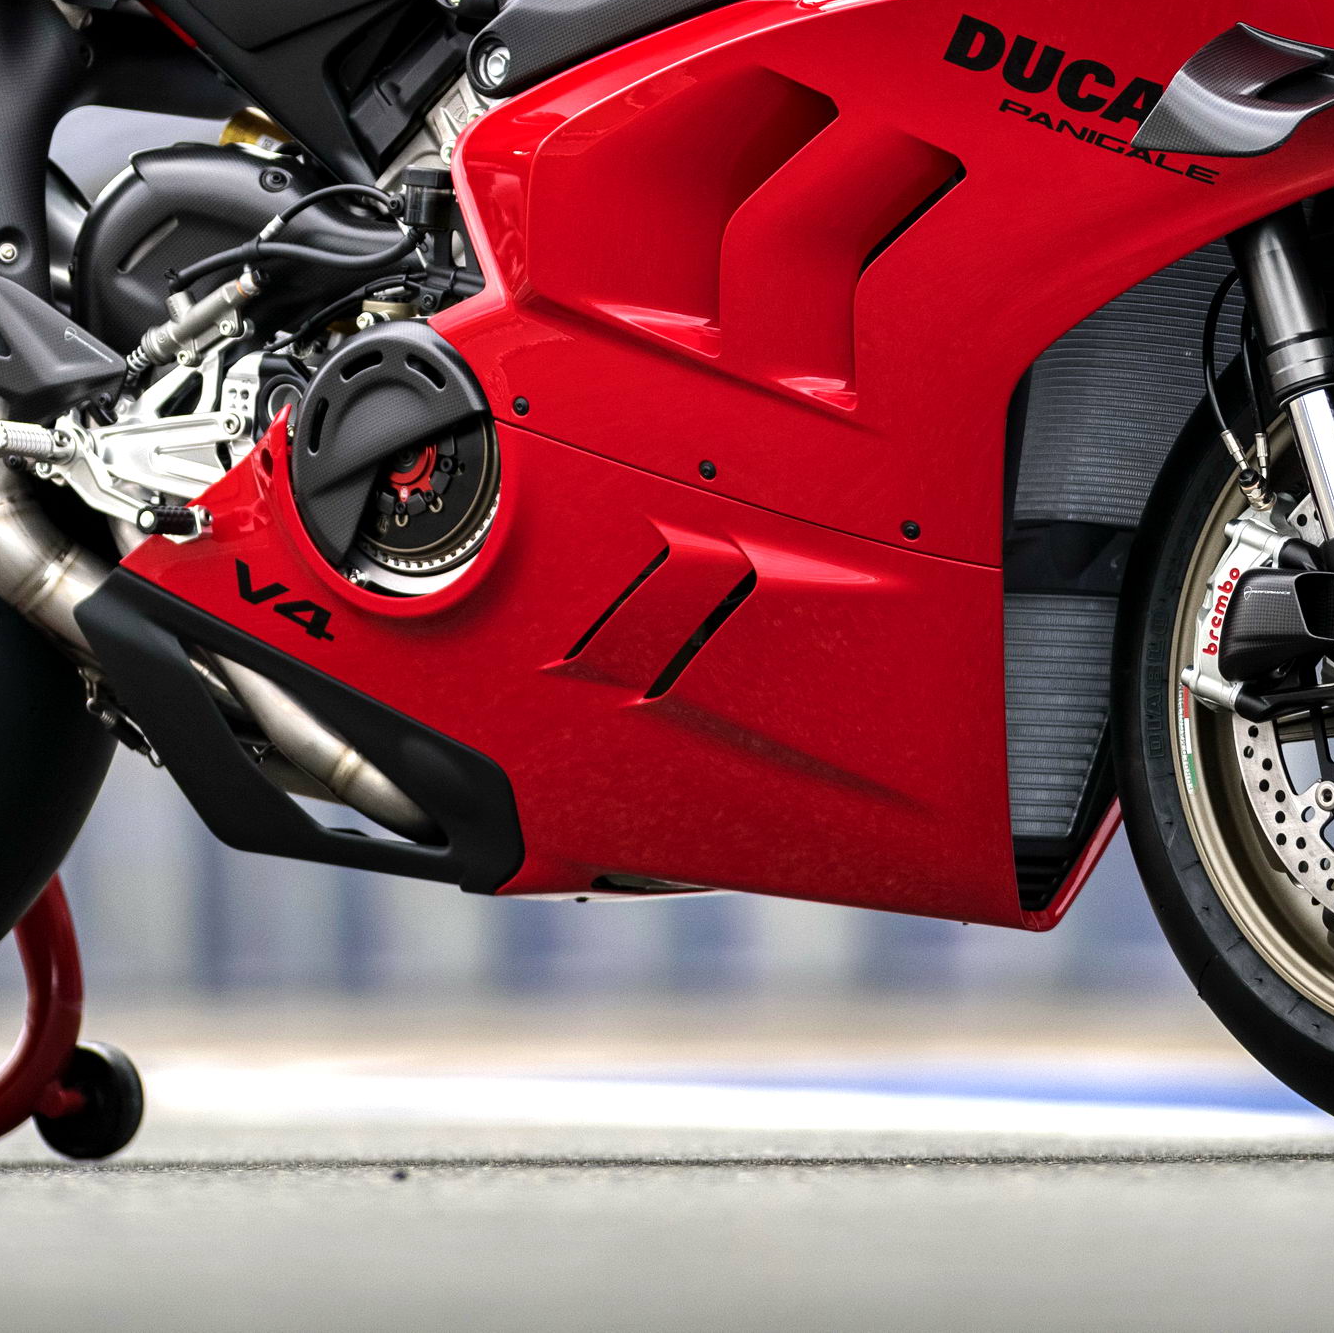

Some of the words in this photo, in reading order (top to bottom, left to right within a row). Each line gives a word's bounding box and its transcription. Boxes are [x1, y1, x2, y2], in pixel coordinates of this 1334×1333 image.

[943, 14, 1166, 125] DUCA
[998, 99, 1221, 185] PANIGALE
[235, 557, 335, 642] V4
[1202, 567, 1241, 656] brembo
[1145, 609, 1168, 758] DIABLO
